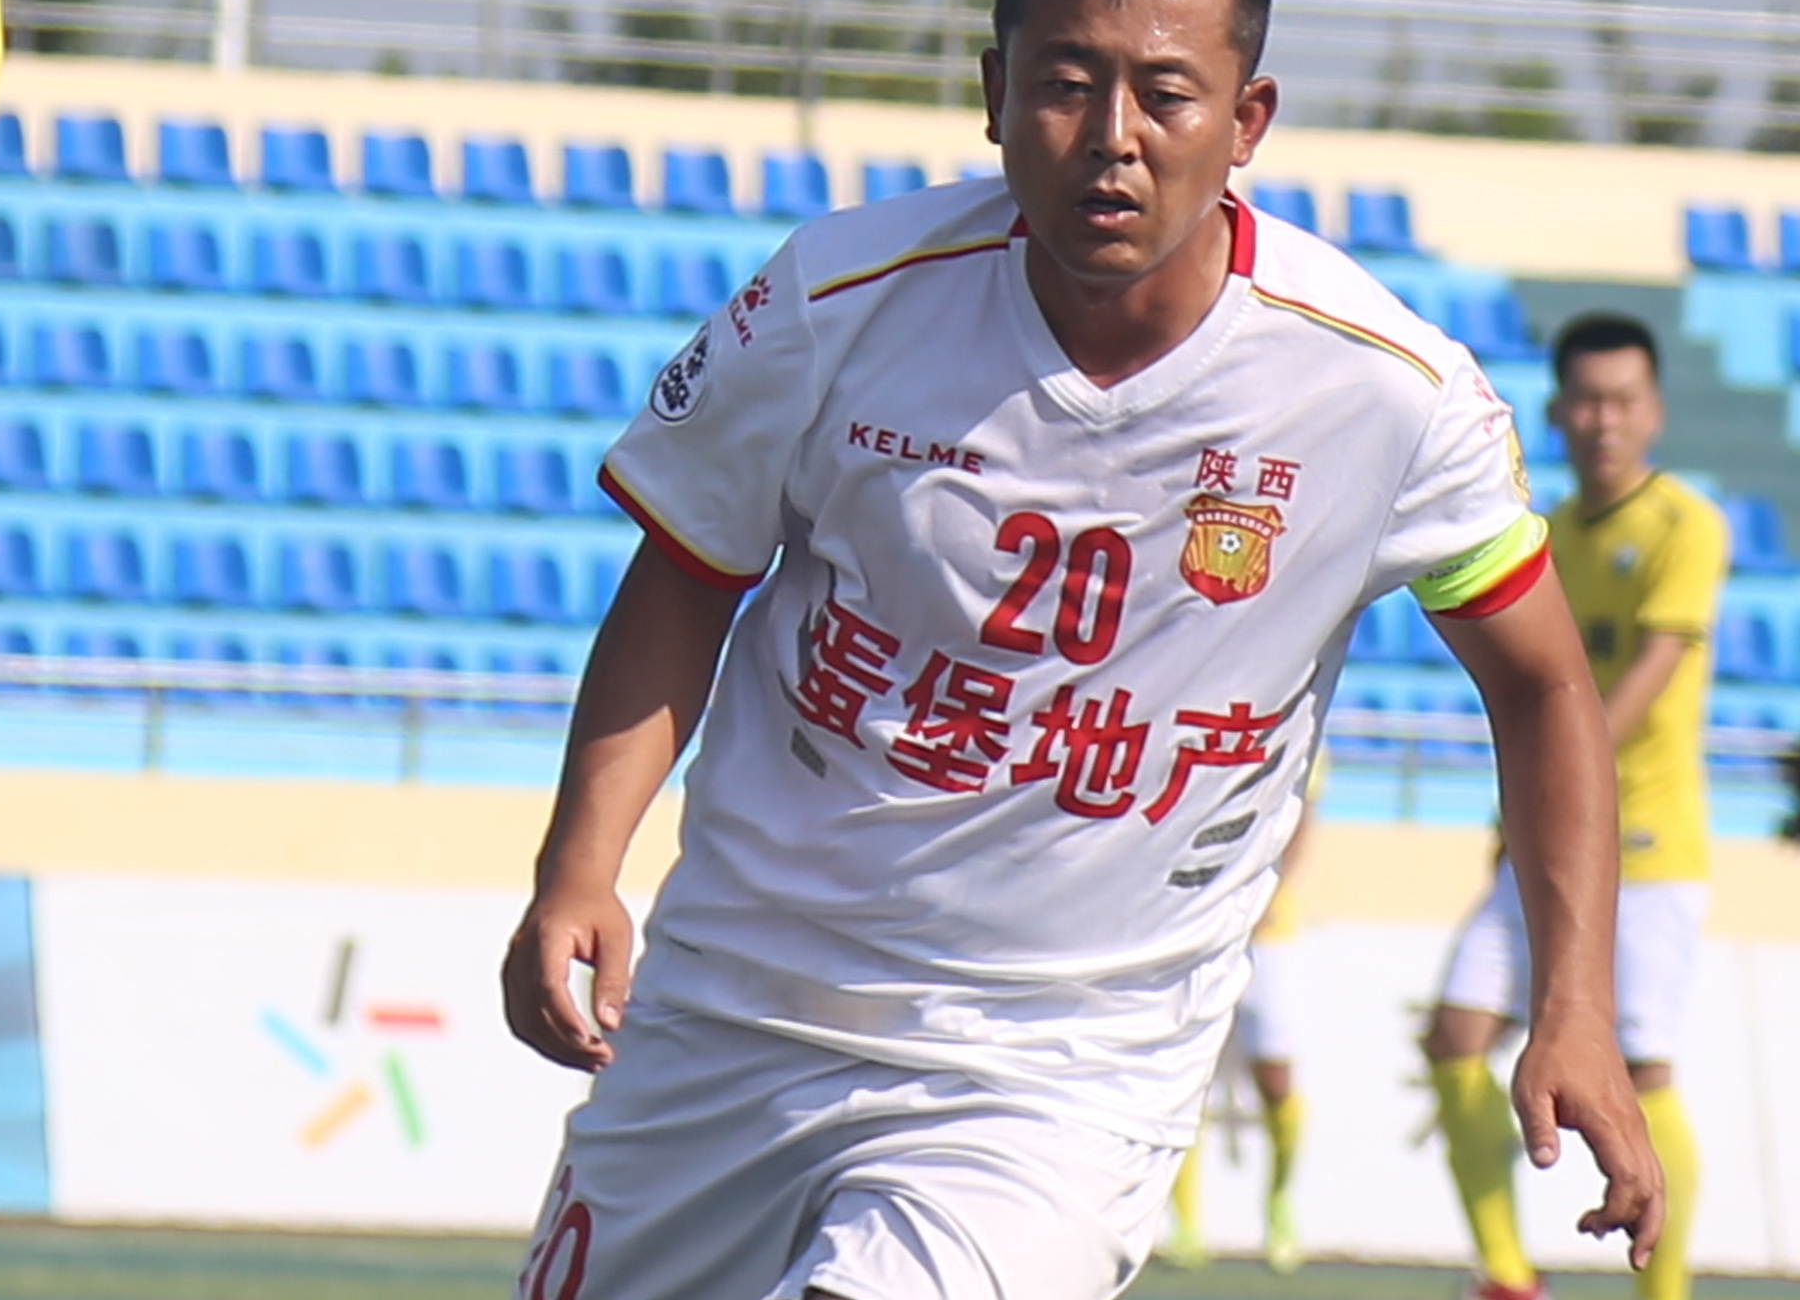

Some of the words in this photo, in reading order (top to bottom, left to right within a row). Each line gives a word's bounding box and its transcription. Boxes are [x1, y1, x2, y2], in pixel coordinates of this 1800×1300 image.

[848, 421, 986, 475] KELME
[1193, 448, 1302, 502] 陕西
[979, 511, 1132, 666] 20
[797, 600, 1283, 826] 蛋堡地产
